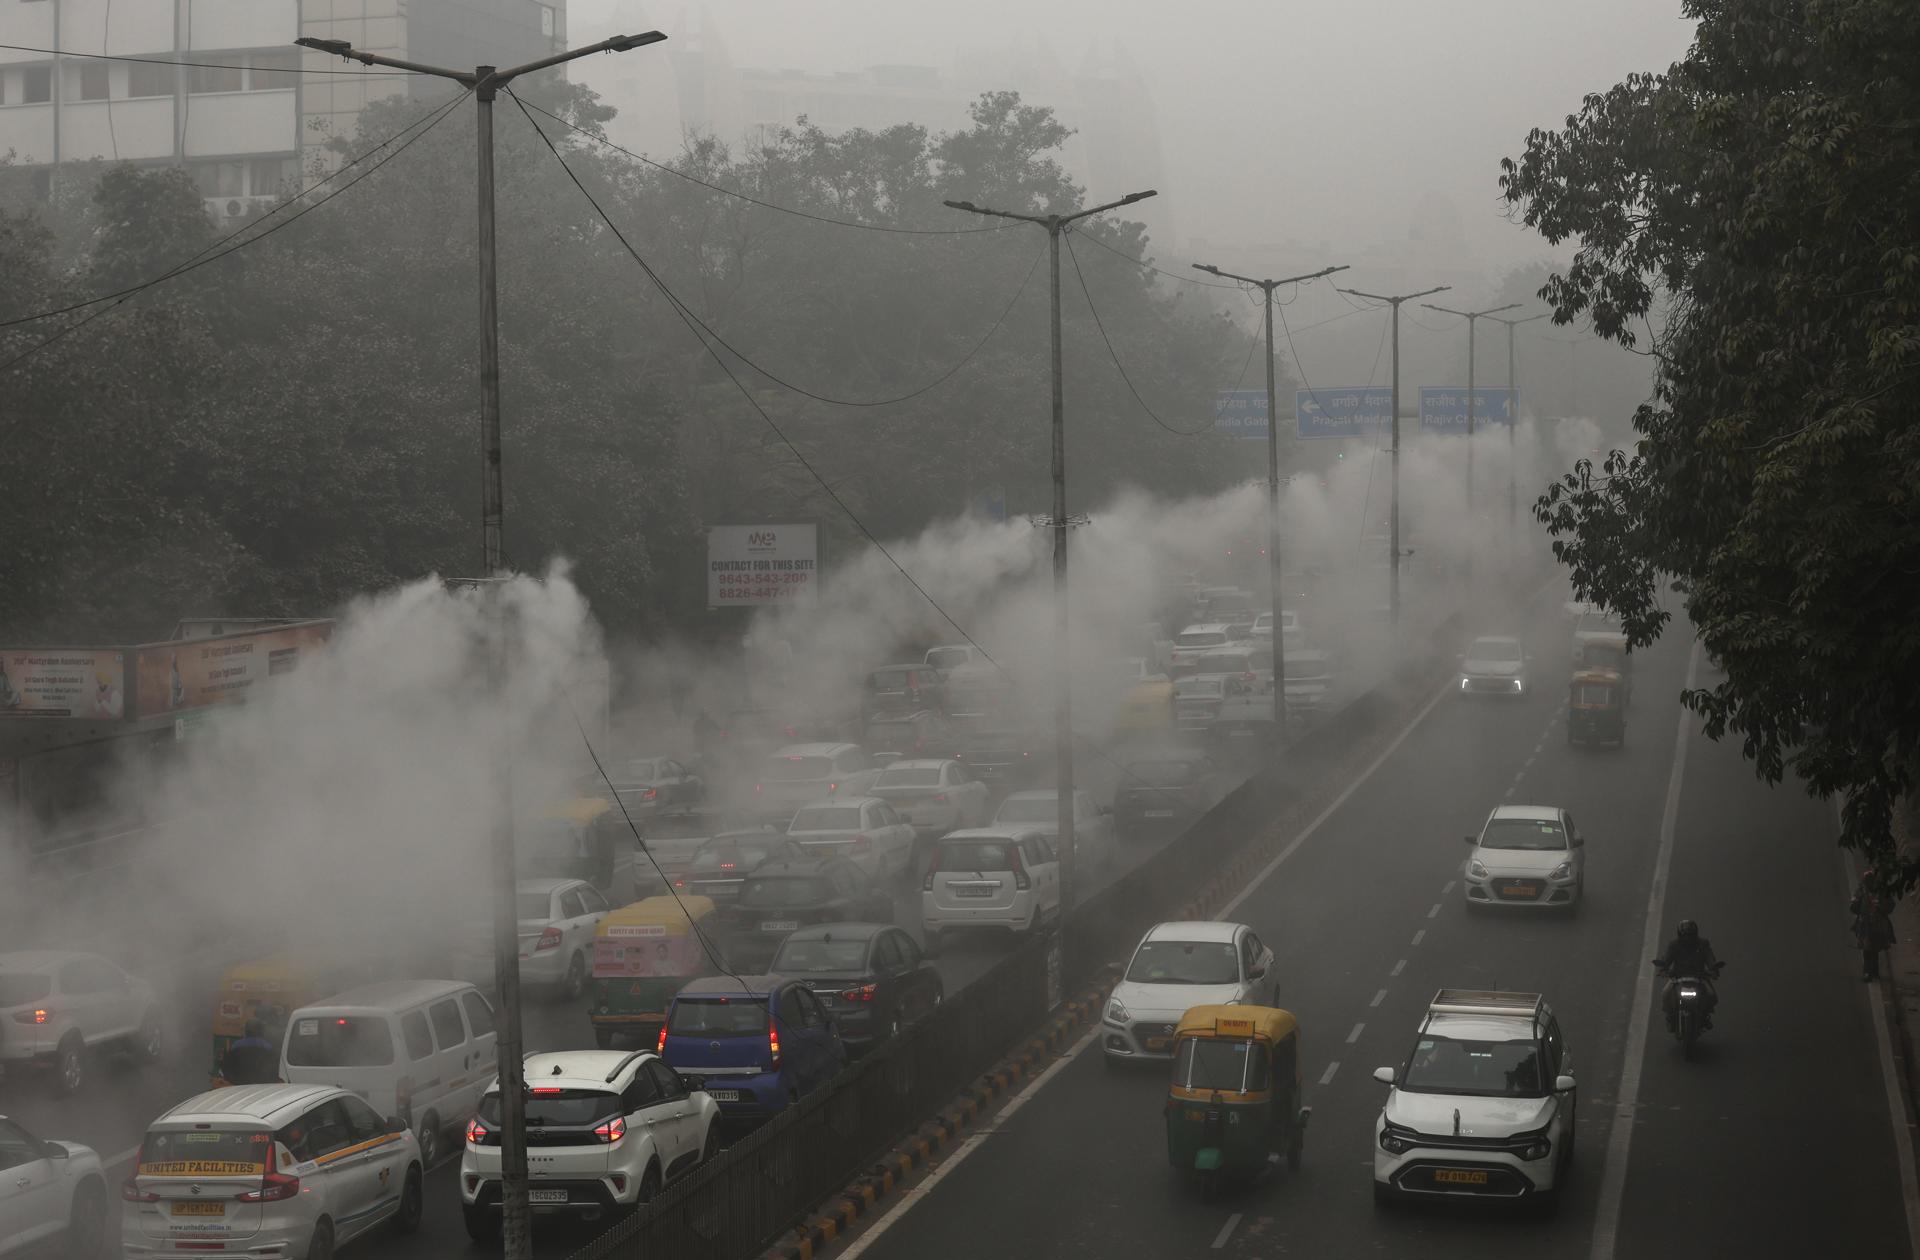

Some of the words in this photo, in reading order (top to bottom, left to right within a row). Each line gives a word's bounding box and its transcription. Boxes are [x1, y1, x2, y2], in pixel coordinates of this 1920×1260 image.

[711, 560, 752, 571] CONTACT
[753, 560, 770, 570] FOR
[771, 560, 793, 570] THIS
[794, 559, 814, 570] SITE
[146, 1162, 186, 1174] UNITED
[188, 1161, 255, 1173] FACILITIES
